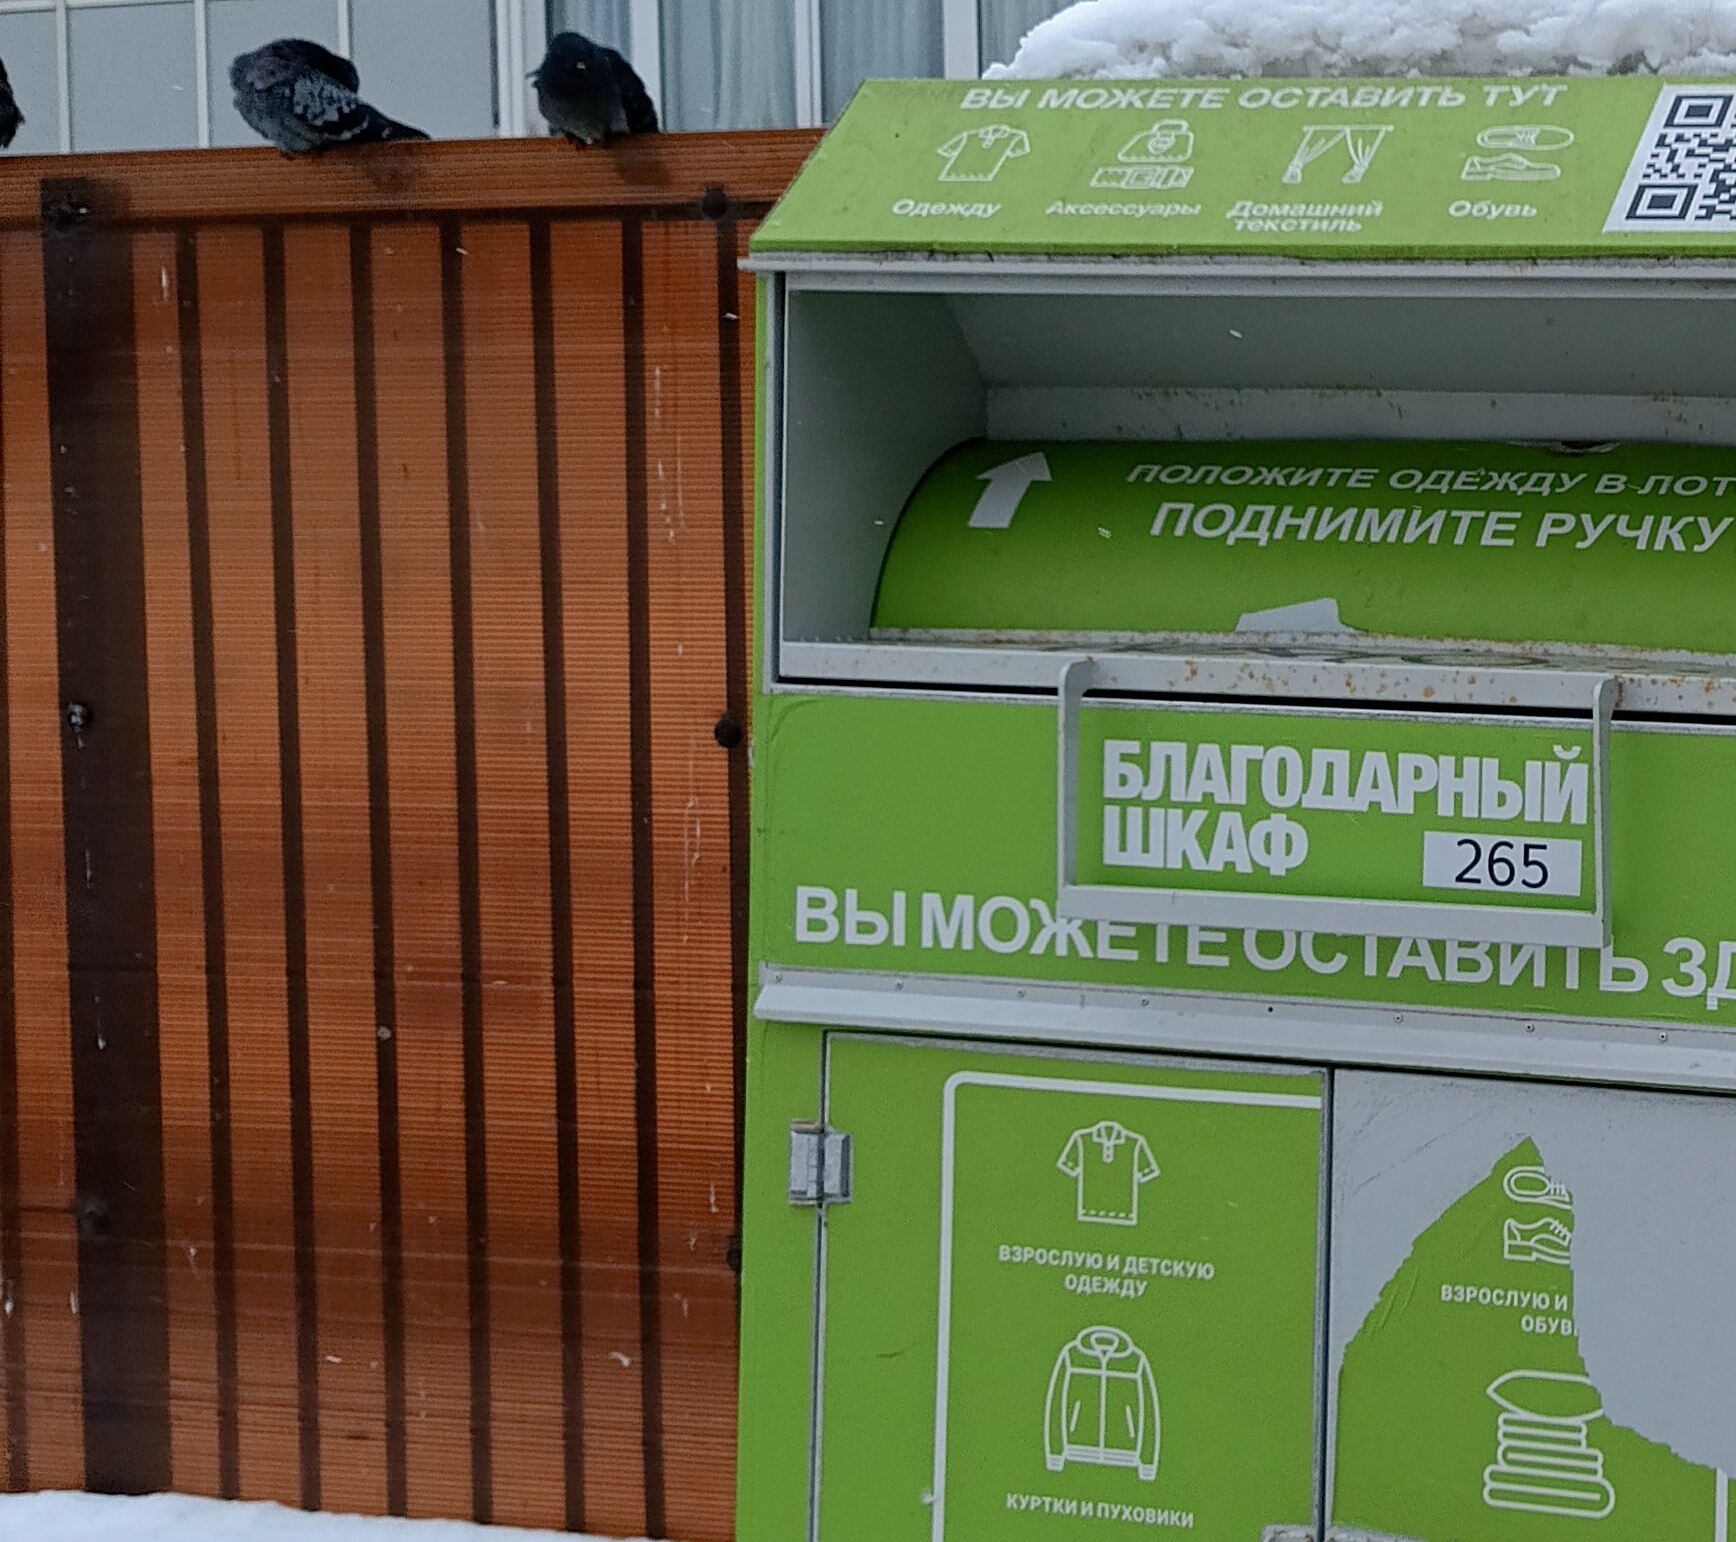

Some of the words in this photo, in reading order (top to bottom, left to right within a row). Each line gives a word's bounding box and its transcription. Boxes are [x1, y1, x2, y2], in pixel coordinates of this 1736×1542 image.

[960, 87, 1026, 111] ВЫ
[1037, 86, 1231, 111] МОЖЕТЕ
[1236, 84, 1467, 110] ОСТАВИТЬ
[1482, 83, 1569, 107] ТУТ
[891, 197, 1003, 219] Одежду
[1045, 199, 1202, 219] Аксессуары
[1226, 198, 1384, 221] Домашний
[1447, 200, 1538, 220] Обувь
[1126, 463, 1380, 492] ПОЛОЖИТЕ
[1389, 467, 1594, 498] ОДЕЖДУ
[1594, 473, 1627, 495] В
[1150, 502, 1525, 548] ПОДНИМИТЕ
[1535, 509, 1735, 555] РУЧКУ
[1101, 738, 1590, 827] БЛАГОДАРНЫЙ
[1101, 804, 1309, 878] ШКАФ
[1454, 838, 1551, 891] 265
[794, 884, 907, 948] ВЫ
[920, 891, 1231, 968] МОЖЕТЕ
[1242, 924, 1650, 994] ОСТАВИТЬ
[998, 1244, 1103, 1270] ВЗРОСЛУЮ
[1105, 1253, 1120, 1271] И
[1123, 1254, 1215, 1281] ДЕТСКУЮ
[1064, 1273, 1148, 1298] ОДЕЖДУ
[1440, 1284, 1551, 1311] ВЗРОСЛУЮ
[1553, 1293, 1568, 1312] И
[1005, 1492, 1078, 1516] КУРТКИ
[1080, 1500, 1094, 1517] И
[1096, 1502, 1194, 1529] ПУХОВИКИ
